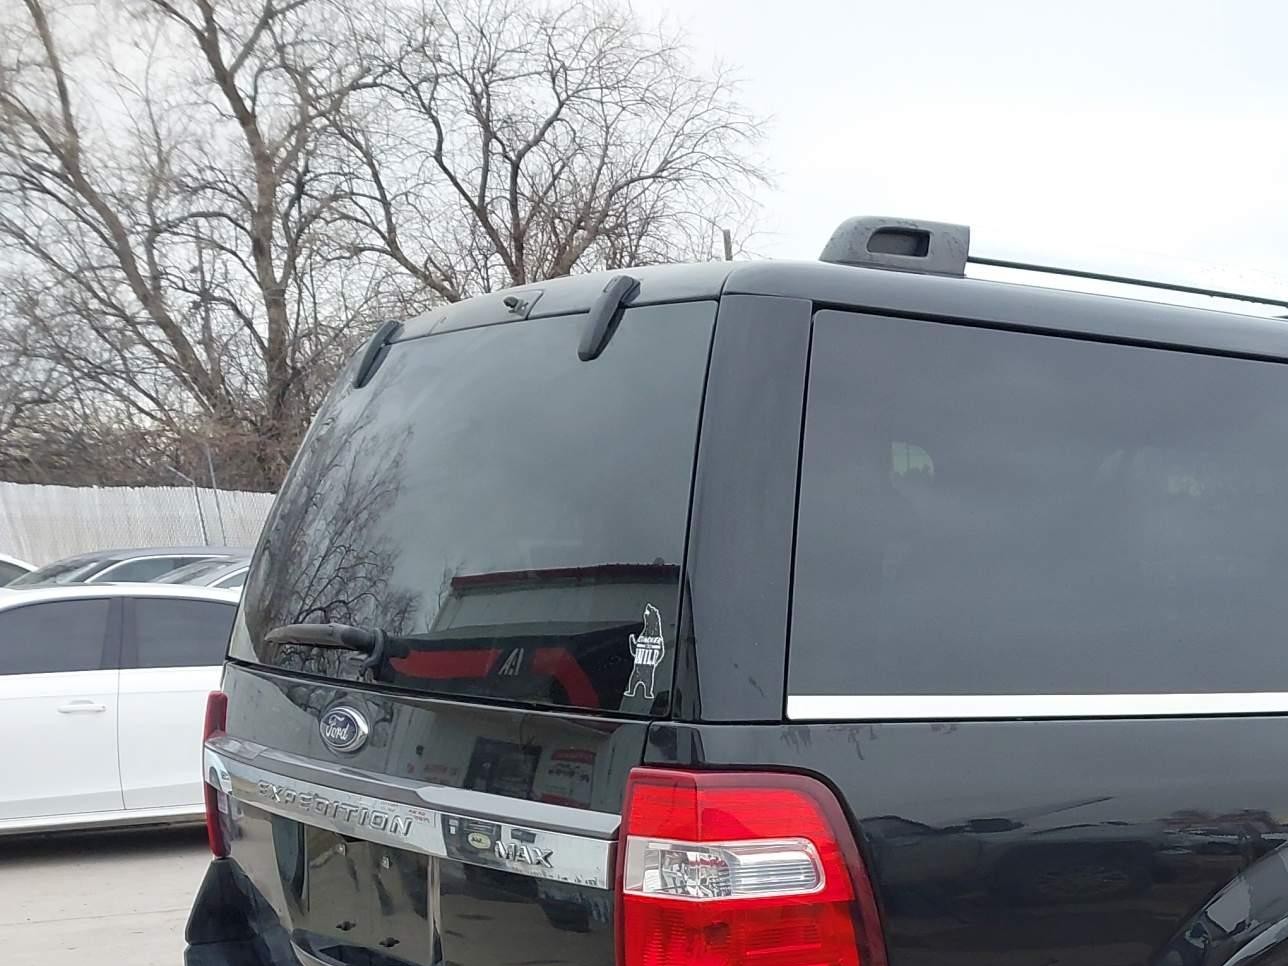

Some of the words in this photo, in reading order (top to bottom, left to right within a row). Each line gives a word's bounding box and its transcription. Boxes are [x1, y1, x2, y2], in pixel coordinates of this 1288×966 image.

[324, 713, 351, 741] Ford
[257, 779, 414, 837] EXPEDITION
[493, 840, 554, 869] MAX
